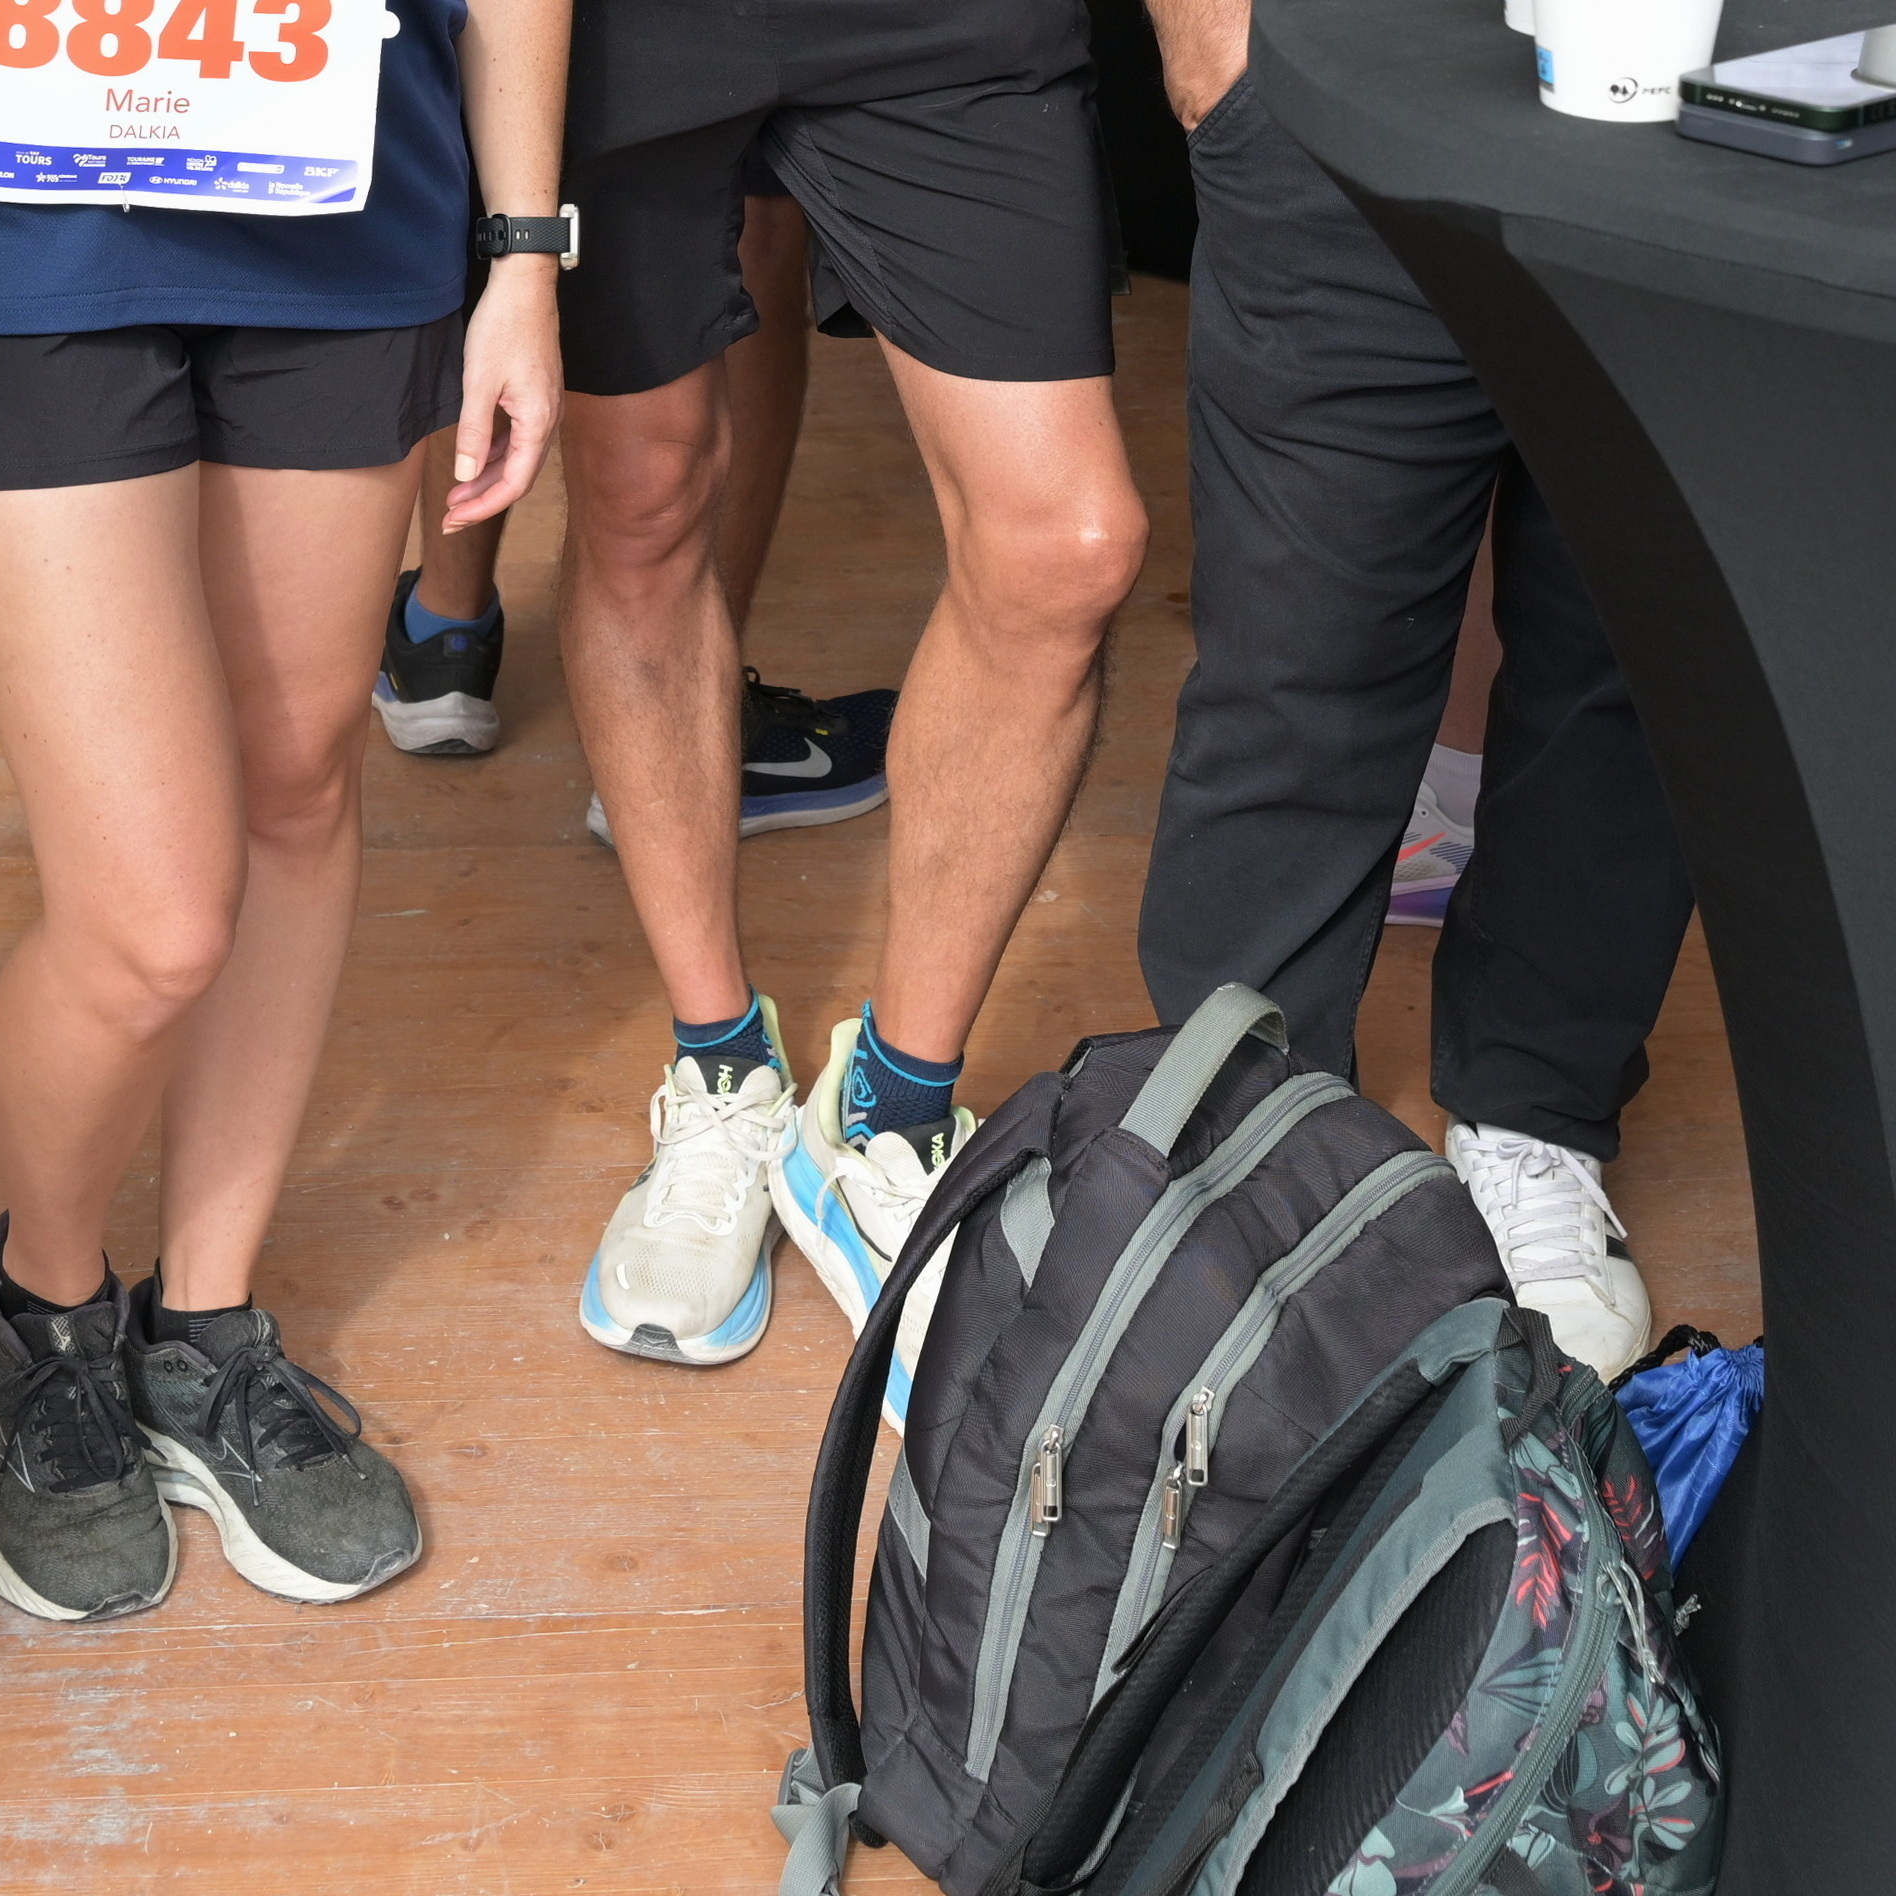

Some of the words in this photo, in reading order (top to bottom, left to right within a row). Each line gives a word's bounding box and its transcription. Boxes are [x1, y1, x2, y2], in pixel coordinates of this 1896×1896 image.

[105, 88, 191, 114] Marie
[109, 124, 181, 140] DALKIA
[15, 154, 52, 166] TOURS
[164, 178, 197, 186] HYUNDAI
[930, 1132, 945, 1169] OKA
